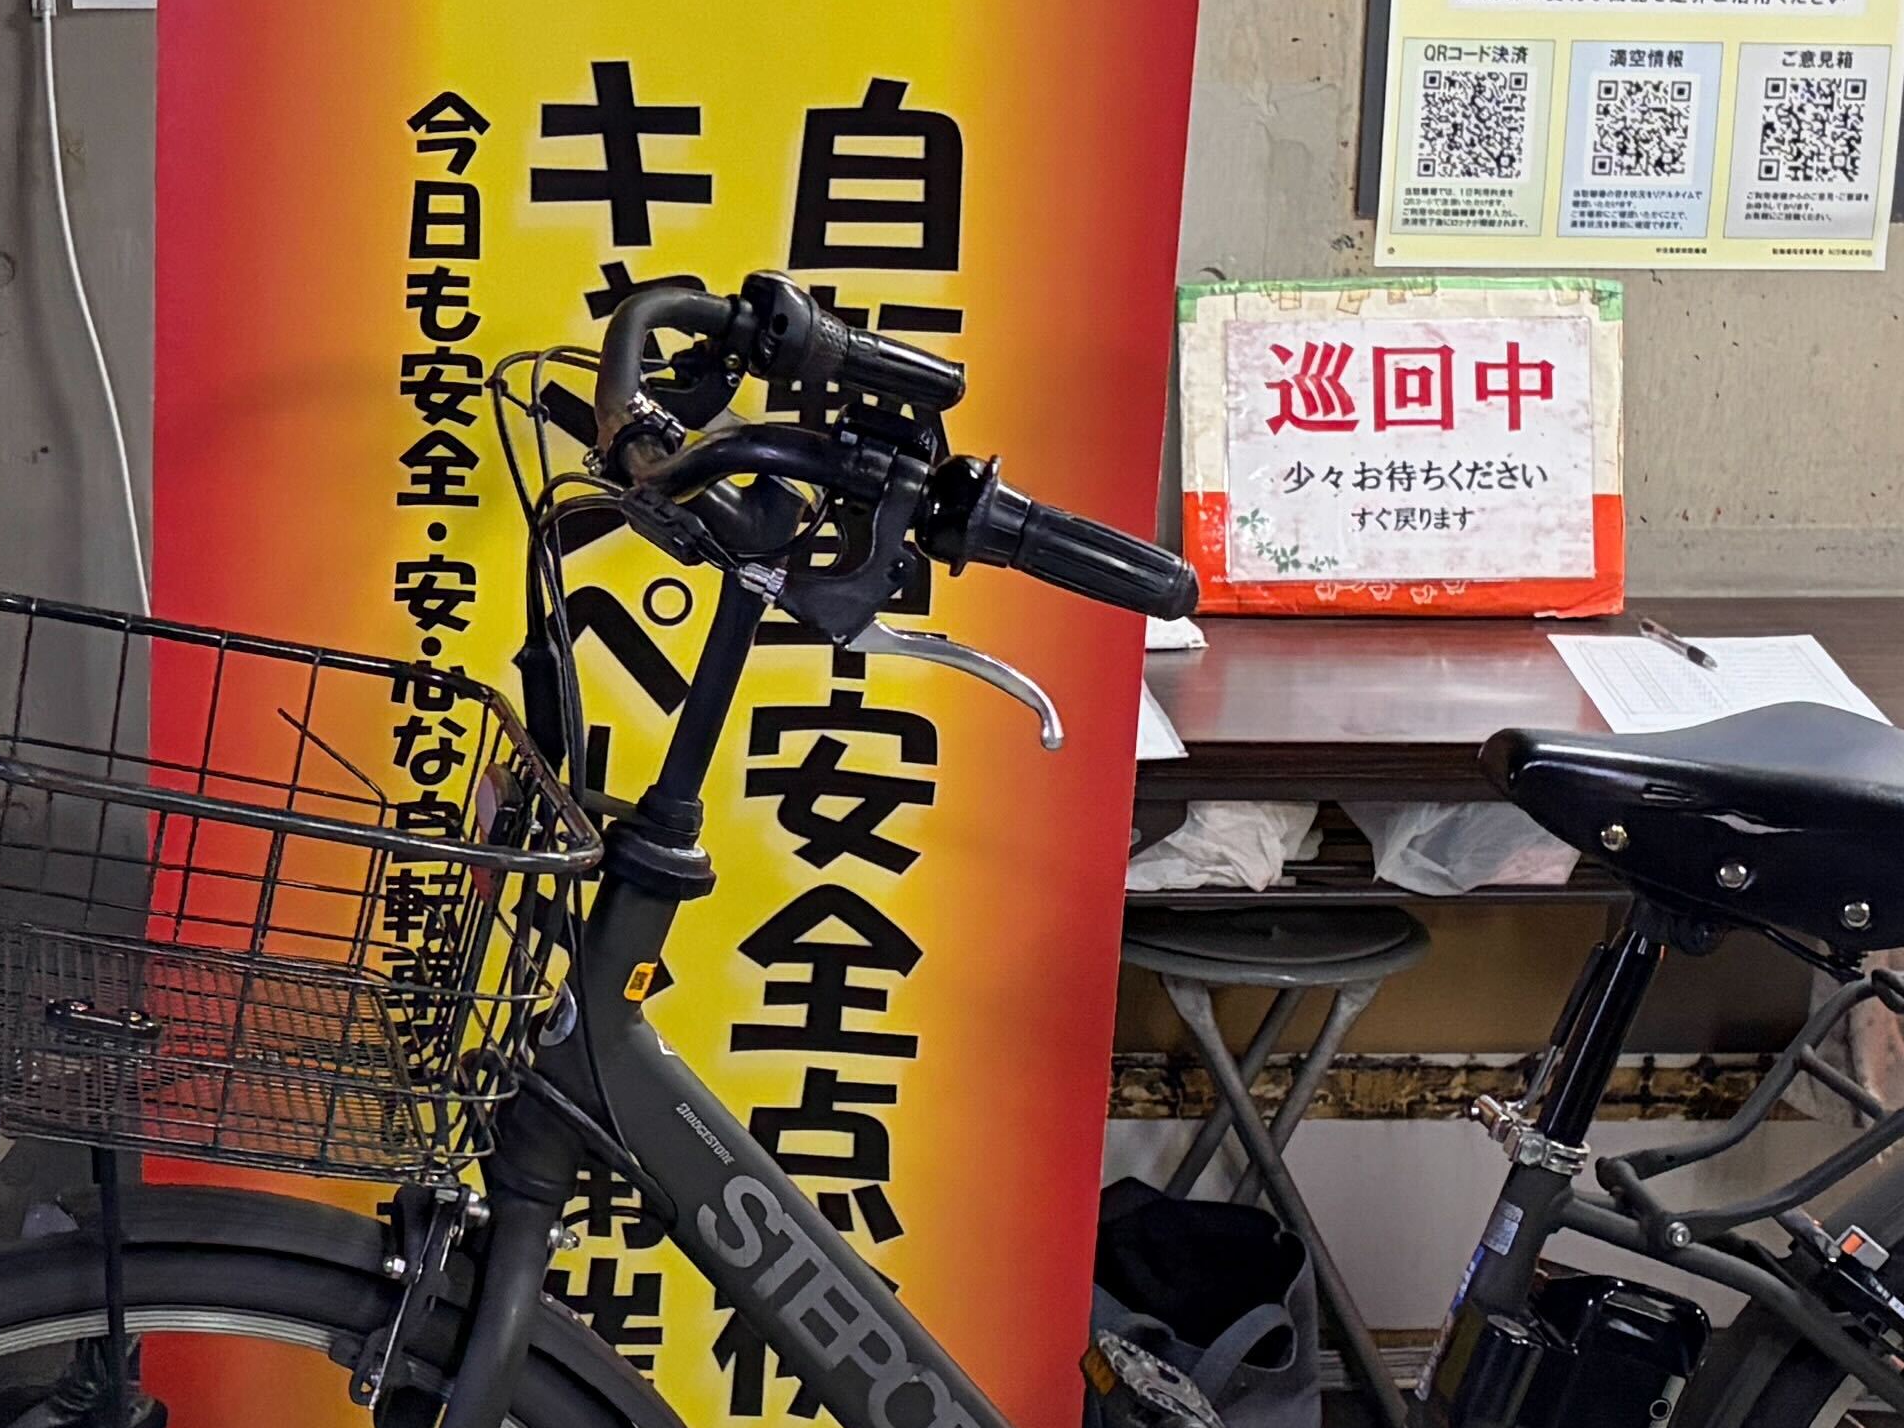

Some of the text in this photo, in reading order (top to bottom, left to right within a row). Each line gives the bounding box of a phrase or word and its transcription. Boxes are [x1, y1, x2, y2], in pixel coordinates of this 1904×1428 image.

[1424, 43, 1530, 65] QRコード決済
[1609, 47, 1685, 69] 満空情報
[1781, 49, 1854, 71] ご意見箱
[1264, 340, 1557, 435] 巡回中
[1283, 459, 1550, 495] 少々お待ちください
[1351, 506, 1476, 533] すぐ戻ります
